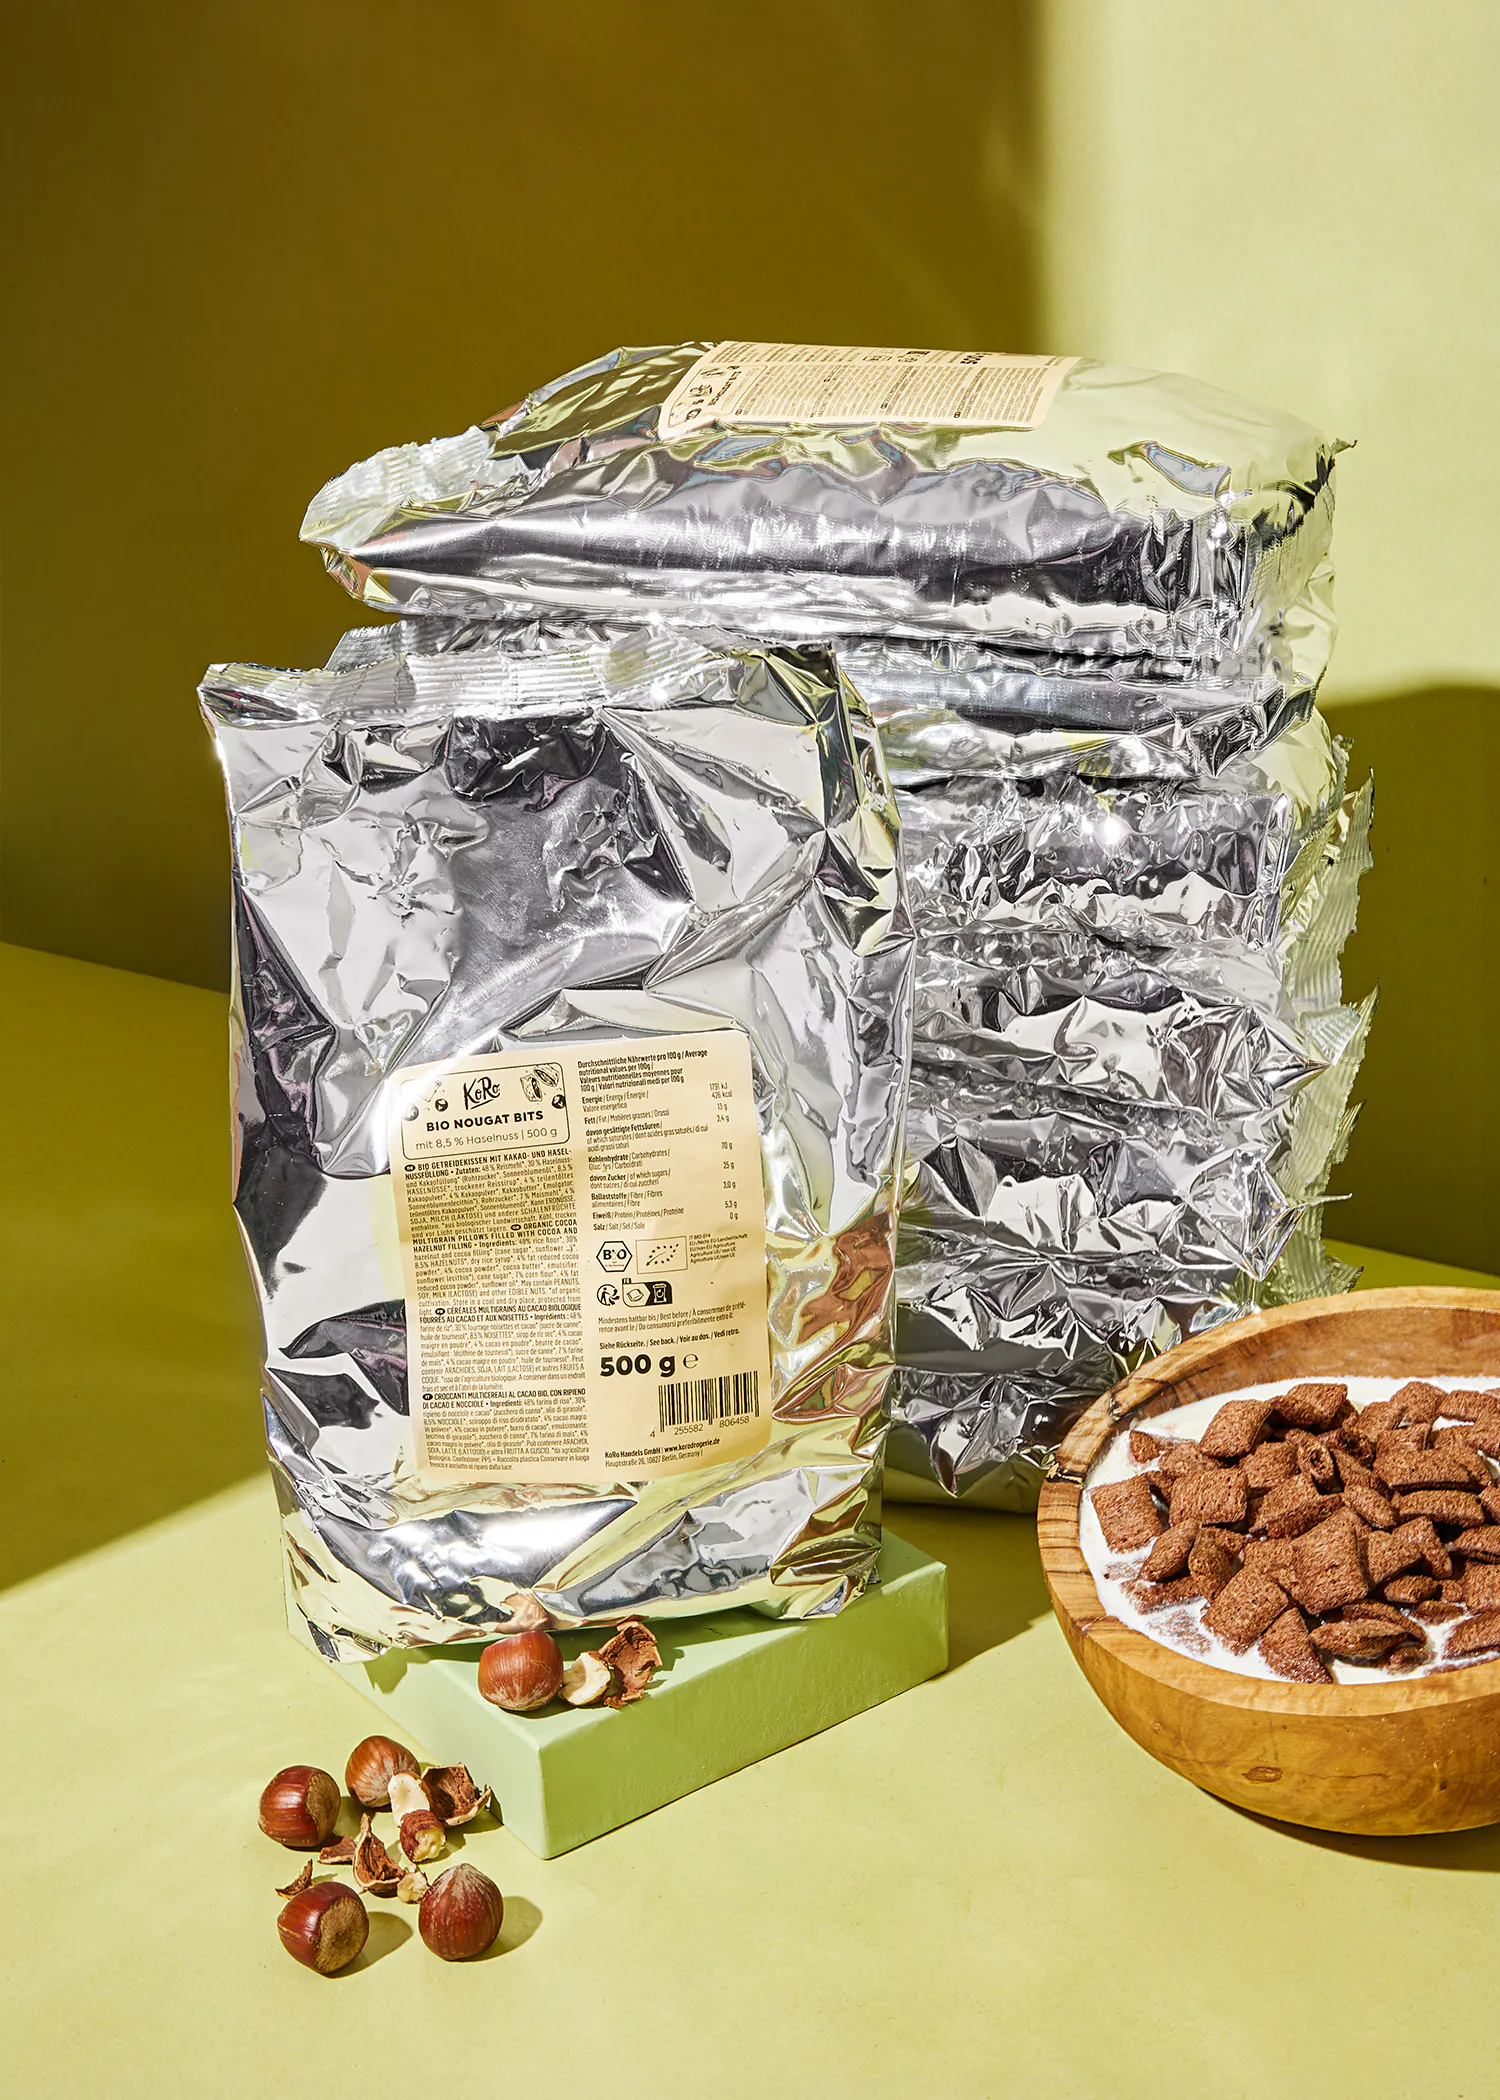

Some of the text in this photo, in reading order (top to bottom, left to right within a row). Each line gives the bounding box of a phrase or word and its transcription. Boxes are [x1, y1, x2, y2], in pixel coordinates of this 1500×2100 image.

[577, 1056, 626, 1069] Durchschnittliche
[627, 1053, 656, 1063] Nährwerte
[656, 1054, 666, 1062] pro
[684, 1050, 707, 1058] Average
[578, 1067, 608, 1076] nutritional
[637, 1064, 650, 1072] 100g
[579, 1068, 682, 1084] Valeurs nutritionnelles moyennes pour
[598, 1082, 614, 1091] Valori
[615, 1079, 646, 1089] nutrizionali
[646, 1078, 660, 1086] medi
[660, 1078, 670, 1086] per
[463, 1076, 501, 1110] KoRo
[721, 1090, 732, 1098] kcal
[582, 1096, 602, 1105] Energie
[426, 1110, 543, 1132] BIO NOUGAT BITS
[584, 1117, 595, 1125] Fett
[631, 1112, 650, 1121] grasses
[653, 1109, 669, 1117] Grassi
[602, 1126, 630, 1136] gesättigte
[630, 1123, 660, 1132] Fettsäuren
[415, 1139, 433, 1151] mit
[453, 1136, 463, 1147] %
[466, 1132, 518, 1145] Haselnuss
[526, 1127, 547, 1139] 500
[549, 1128, 557, 1139] g
[417, 1163, 429, 1171] BIO
[431, 1156, 487, 1169] GETREIDEKISSEN
[489, 1155, 501, 1163] MIT
[531, 1150, 545, 1158] UND
[588, 1150, 667, 1163] Kohlenhydrate Carbohydrates
[405, 1165, 481, 1180] NUSSFÜLLUNG Zutaten:
[591, 1192, 626, 1201] Ballaststoffe
[635, 1209, 660, 1217] Protéines
[523, 1221, 553, 1230] ORGANIC
[554, 1219, 577, 1227] COCOA
[412, 1235, 455, 1245] MULTIGRAIN
[457, 1232, 488, 1241] PILLOWS
[490, 1230, 514, 1239] FILLED
[516, 1229, 535, 1237] WITH
[537, 1227, 560, 1236] COCOA
[413, 1239, 517, 1252] HAZELNUT FILLING Ingredients:
[446, 1305, 476, 1314] CÉRÉALES
[477, 1305, 516, 1313] MULTIGRAINS
[547, 1303, 581, 1311] BIOLOGIQUE
[419, 1315, 445, 1323] FOURRÉS
[533, 1313, 565, 1322] Ingrédients
[615, 1340, 645, 1349] Rückseite.
[660, 1337, 675, 1345] back.
[713, 1329, 725, 1338] Vedi
[725, 1328, 739, 1336] retro.
[600, 1353, 651, 1378] 500
[659, 1356, 675, 1378] g
[434, 1392, 466, 1400] CROCCANTI
[467, 1391, 507, 1399] MULTICEREALI
[562, 1388, 585, 1396] RIPIENO
[674, 1416, 750, 1435] 255582 806458
[620, 1449, 643, 1457] Handels
[643, 1446, 660, 1455] GmbH
[663, 1438, 720, 1452] www.korodrogerie.de
